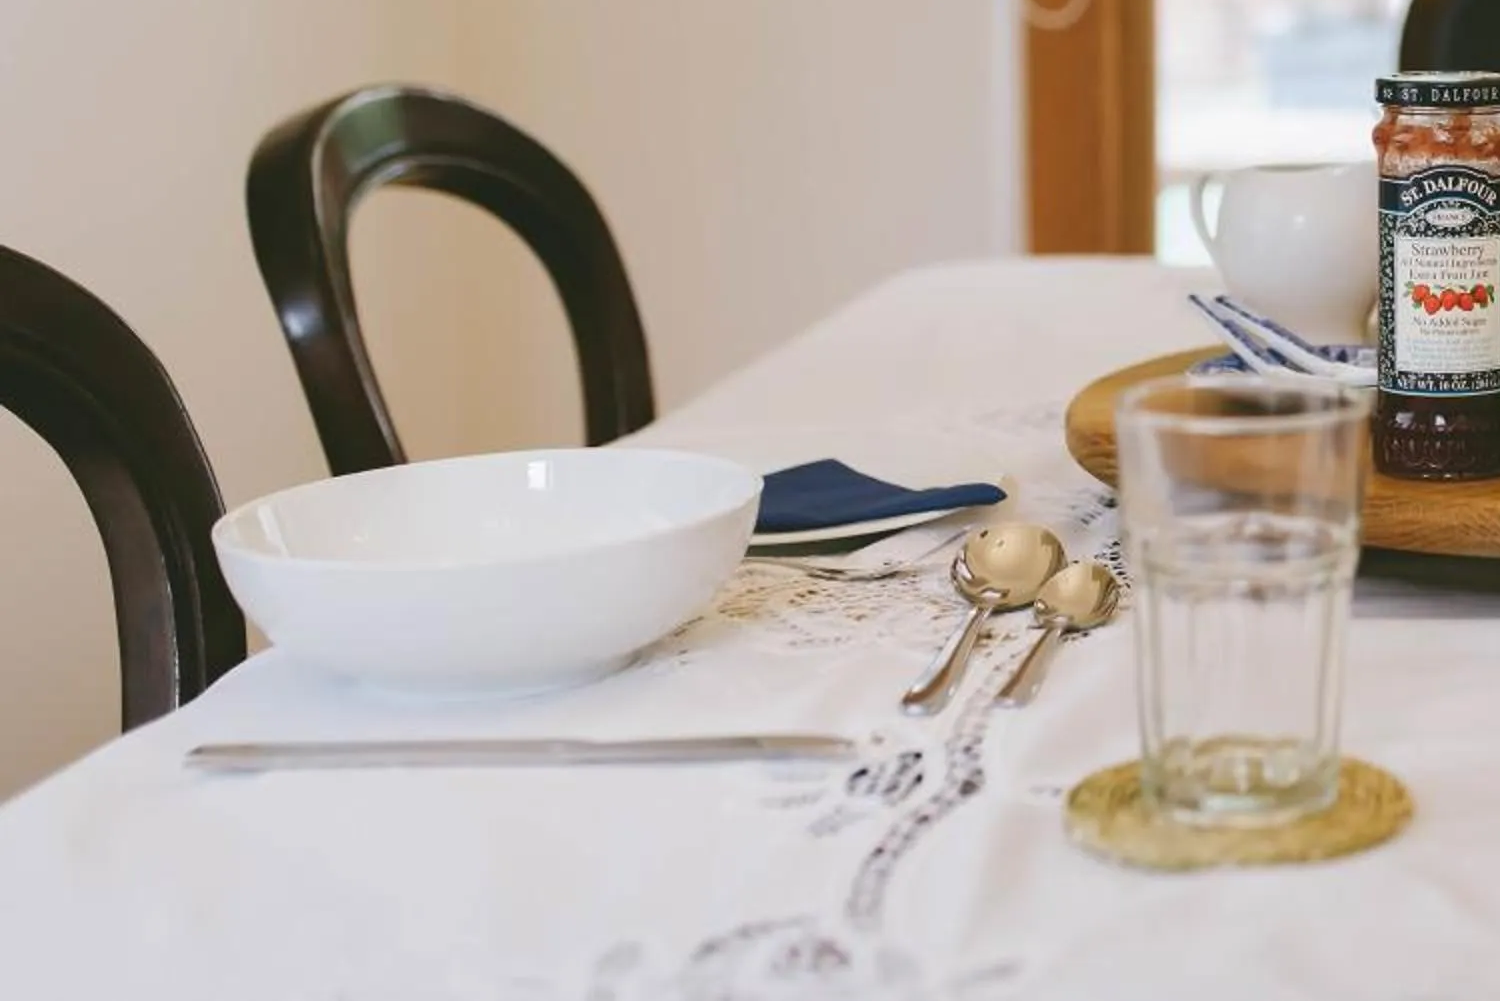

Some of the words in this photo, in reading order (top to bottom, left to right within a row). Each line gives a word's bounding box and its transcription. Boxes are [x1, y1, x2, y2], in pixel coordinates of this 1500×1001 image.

[1401, 87, 1423, 101] ST.
[1431, 86, 1500, 102] DALFOUR
[1401, 186, 1423, 207] ST.
[1425, 176, 1497, 207] DALFOUR
[1411, 242, 1484, 261] Strawberry
